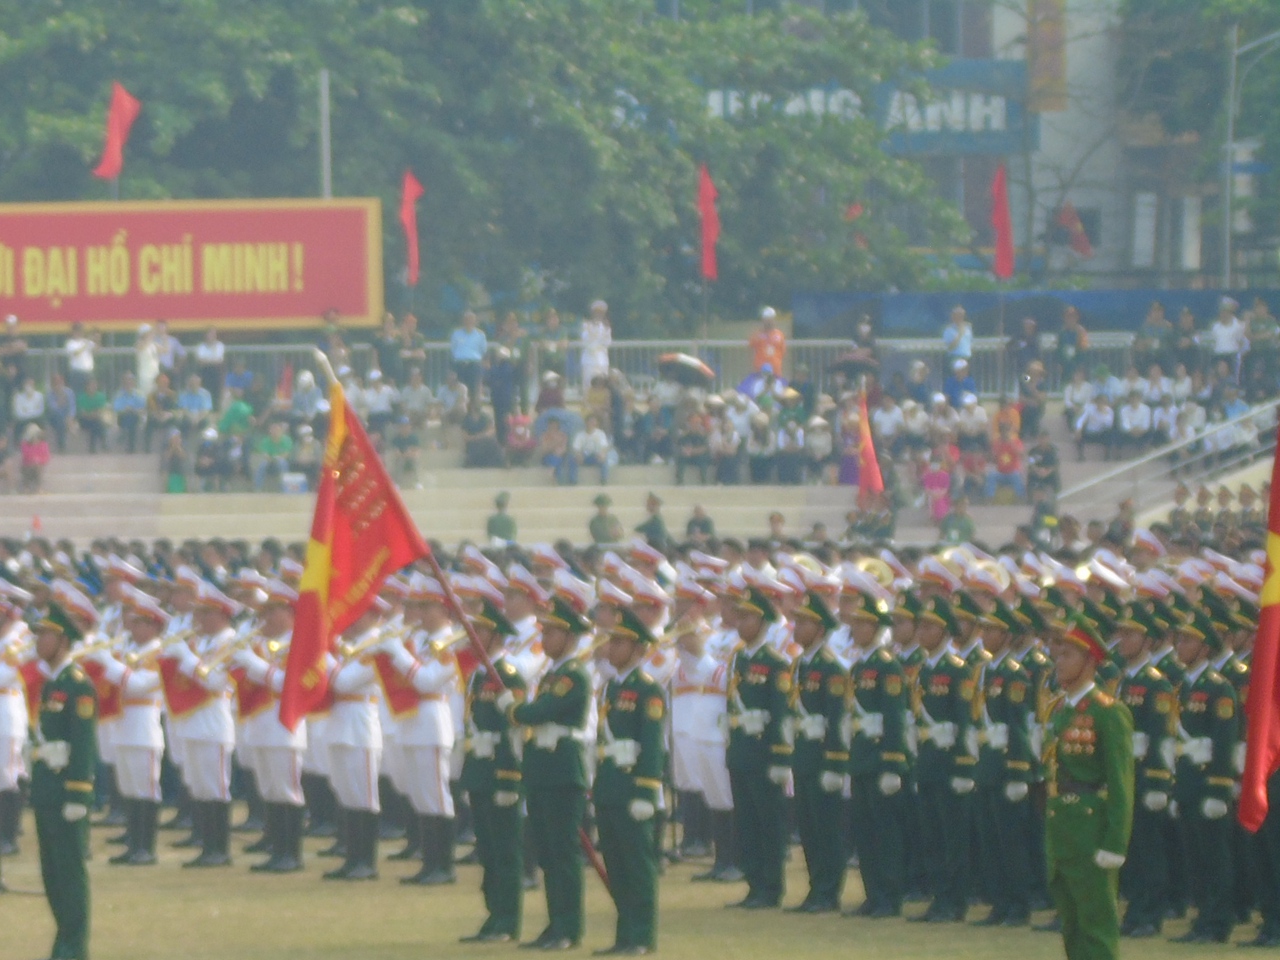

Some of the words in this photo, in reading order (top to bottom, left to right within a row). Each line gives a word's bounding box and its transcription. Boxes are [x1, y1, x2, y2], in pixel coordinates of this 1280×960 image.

[887, 88, 1007, 132] ANH
[24, 246, 78, 308] ĐẠI
[86, 228, 130, 297] HỒ
[139, 233, 193, 296] CHÍ
